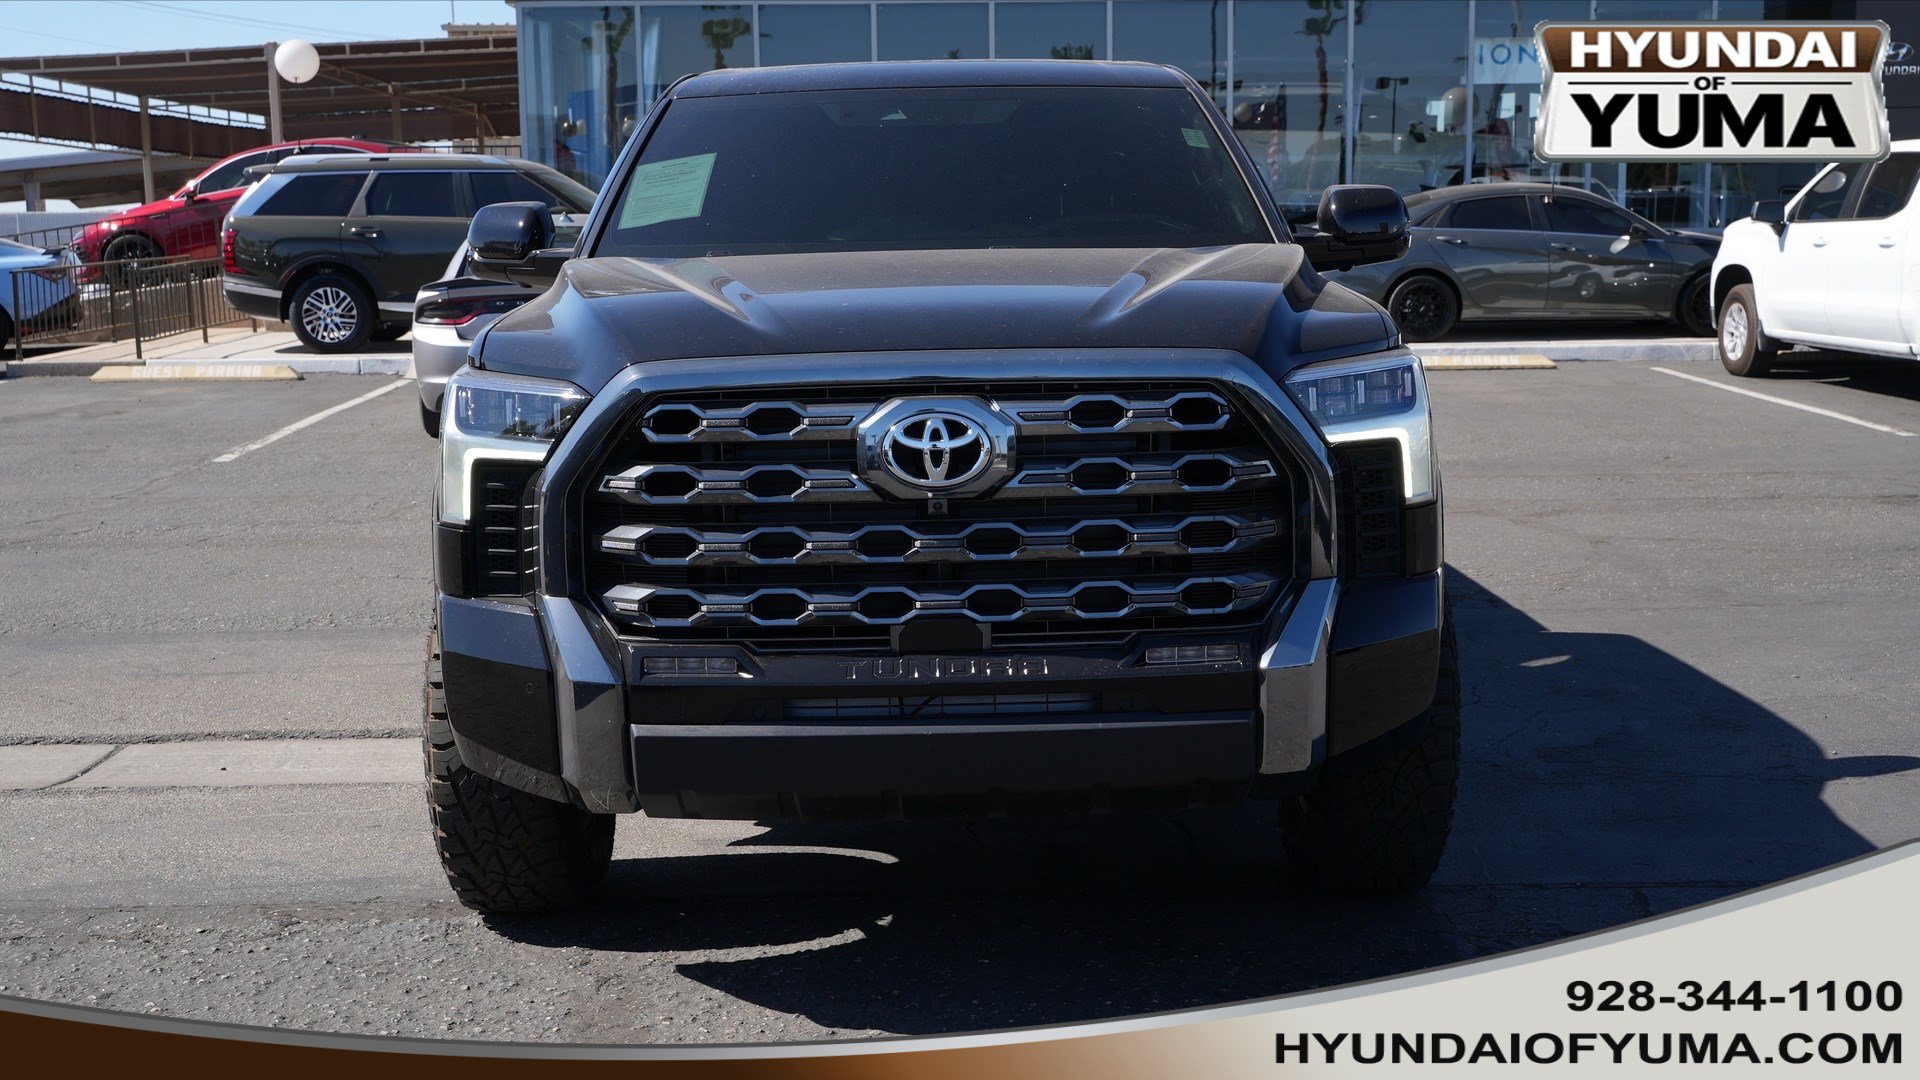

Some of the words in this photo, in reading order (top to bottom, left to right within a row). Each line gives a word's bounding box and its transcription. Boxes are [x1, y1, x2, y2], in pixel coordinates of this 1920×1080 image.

[1478, 44, 1538, 65] ION
[1884, 65, 1920, 76] UNDAI
[132, 366, 182, 378] GUEST
[195, 365, 262, 378] PARKING
[837, 657, 1049, 679] TUNDRA
